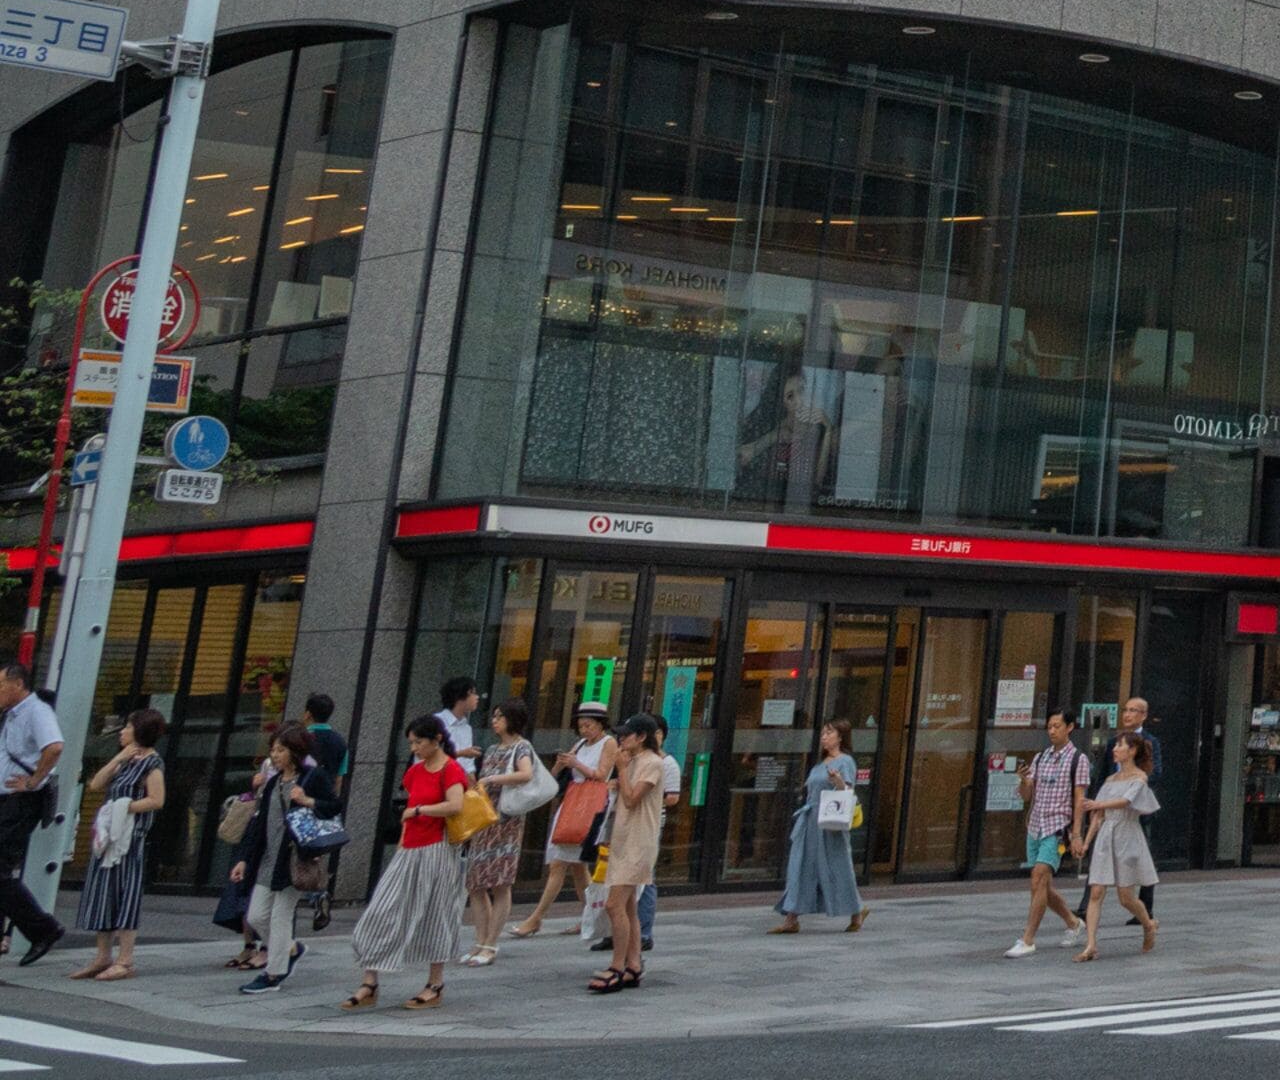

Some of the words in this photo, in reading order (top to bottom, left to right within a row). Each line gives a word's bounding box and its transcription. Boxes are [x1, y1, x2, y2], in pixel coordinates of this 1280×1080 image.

[35, 46, 48, 62] 3
[169, 487, 214, 500] ここから
[613, 519, 654, 534] MUFG
[911, 538, 972, 555] 三菱UFJ銀行
